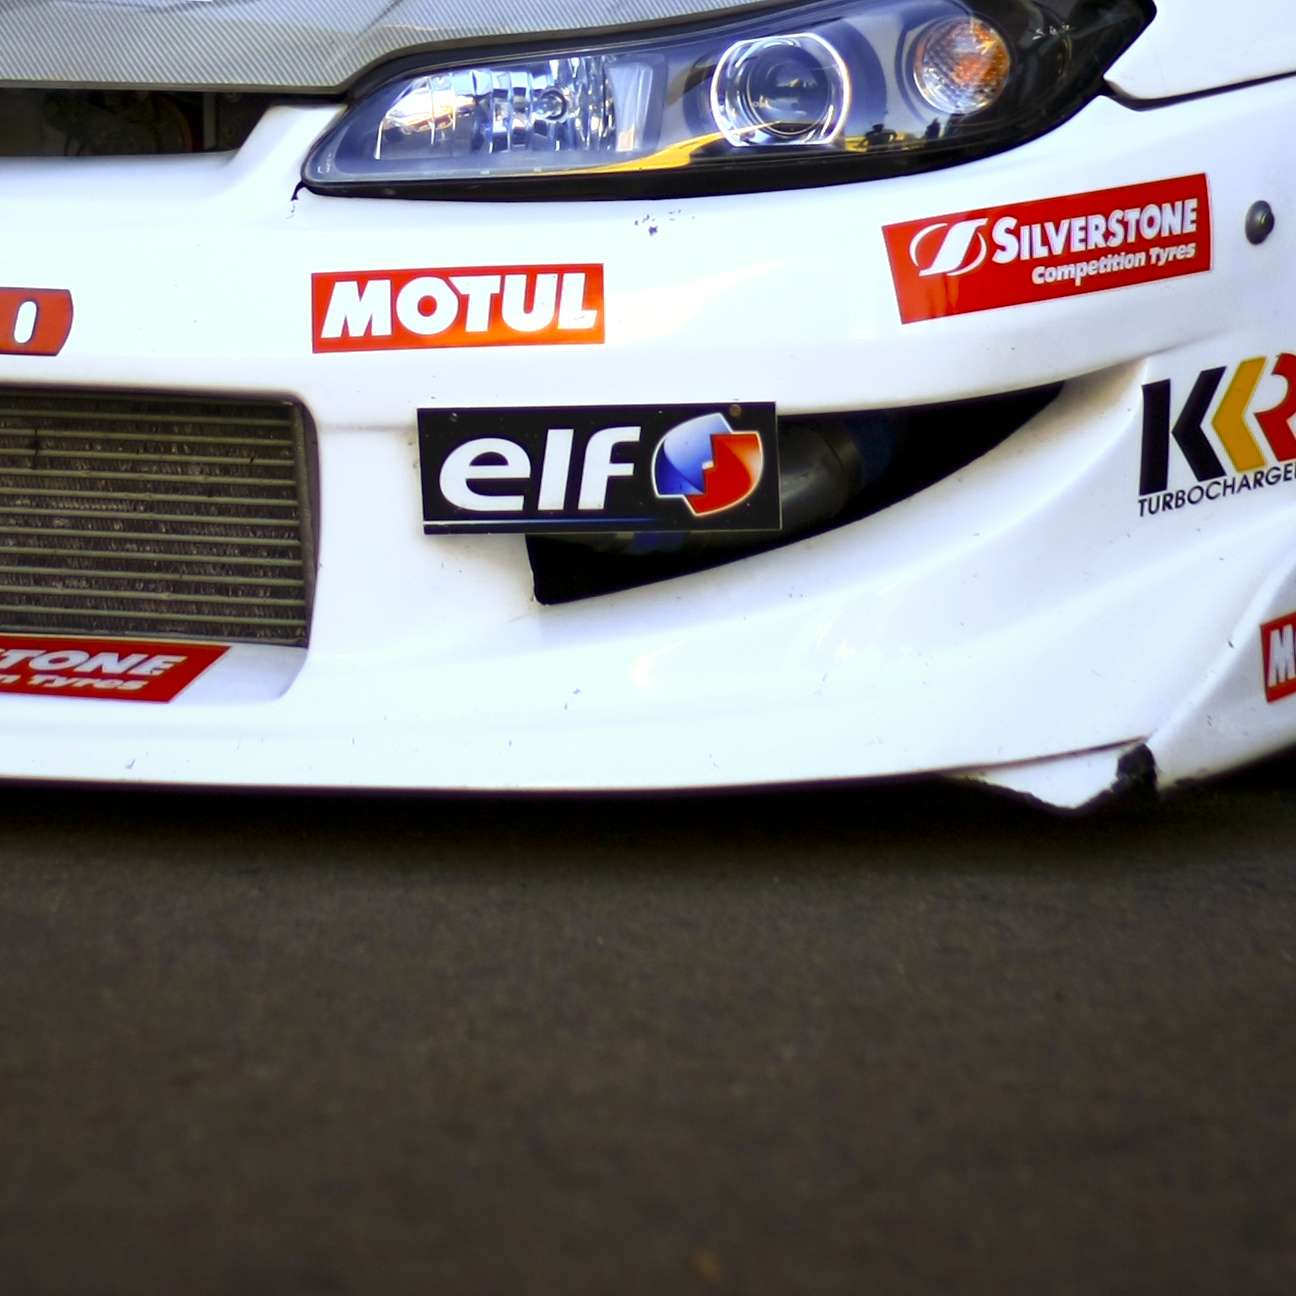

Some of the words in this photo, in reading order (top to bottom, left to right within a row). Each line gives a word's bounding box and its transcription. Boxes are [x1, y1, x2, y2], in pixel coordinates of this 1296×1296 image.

[992, 198, 1199, 266] SILVERSTONE
[1031, 251, 1146, 288] Competition
[1148, 242, 1197, 273] Tyres
[319, 271, 599, 339] MOTUL
[438, 424, 642, 513] elf
[25, 673, 151, 692] Tyres
